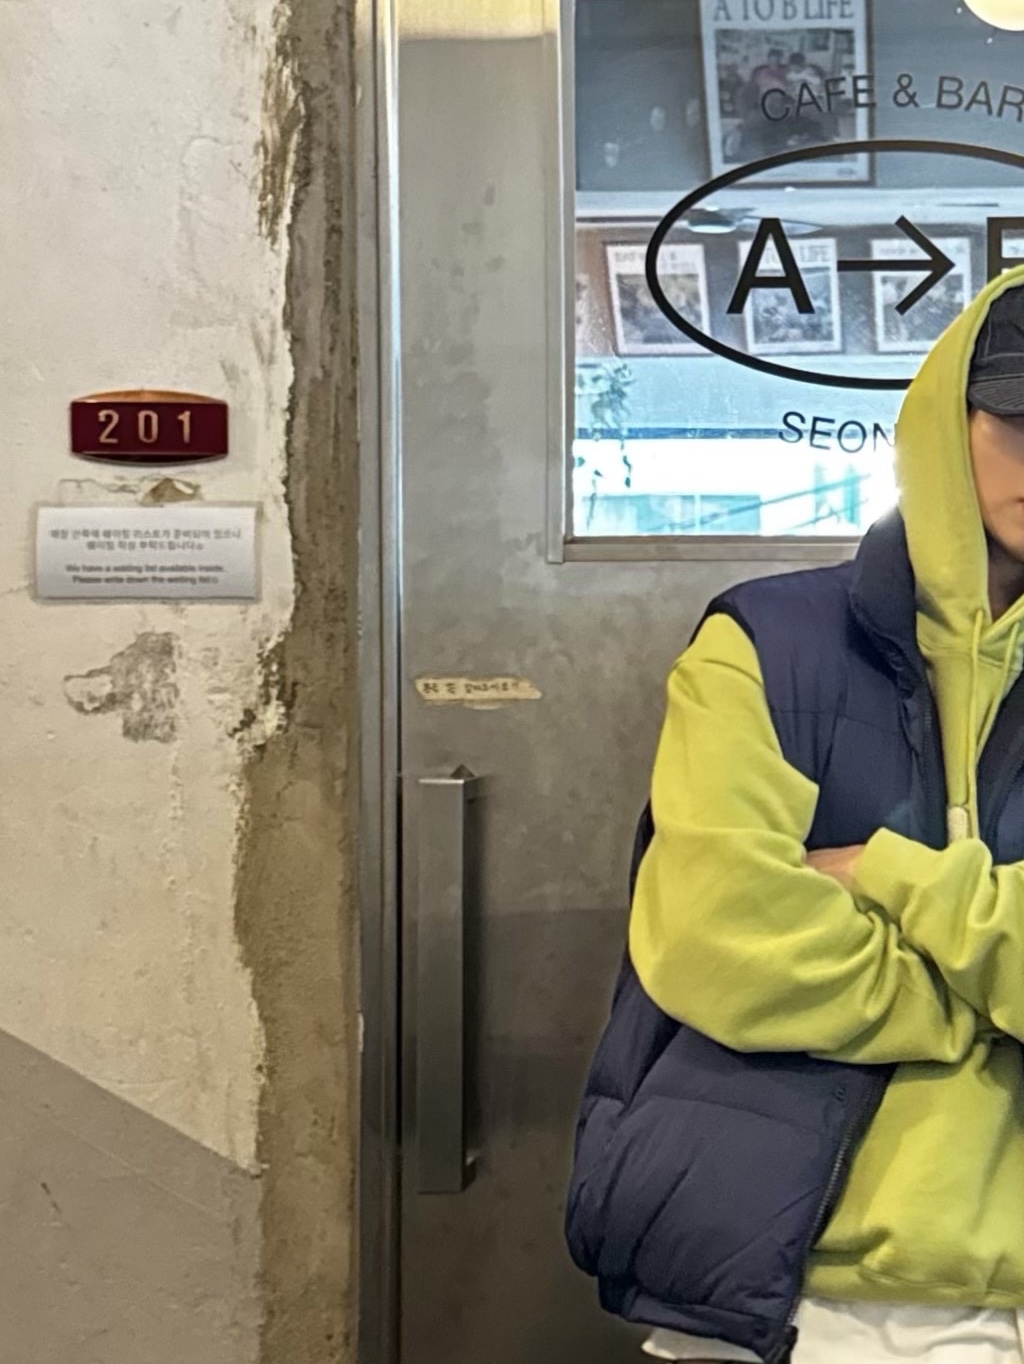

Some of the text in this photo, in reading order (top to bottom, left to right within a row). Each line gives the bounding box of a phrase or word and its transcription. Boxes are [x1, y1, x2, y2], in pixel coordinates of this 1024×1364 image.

[714, 0, 732, 21] A
[804, 0, 855, 20] LIFE
[760, 74, 877, 122] CAFE
[892, 73, 920, 109] &
[727, 217, 815, 315] A
[97, 409, 192, 444] 201
